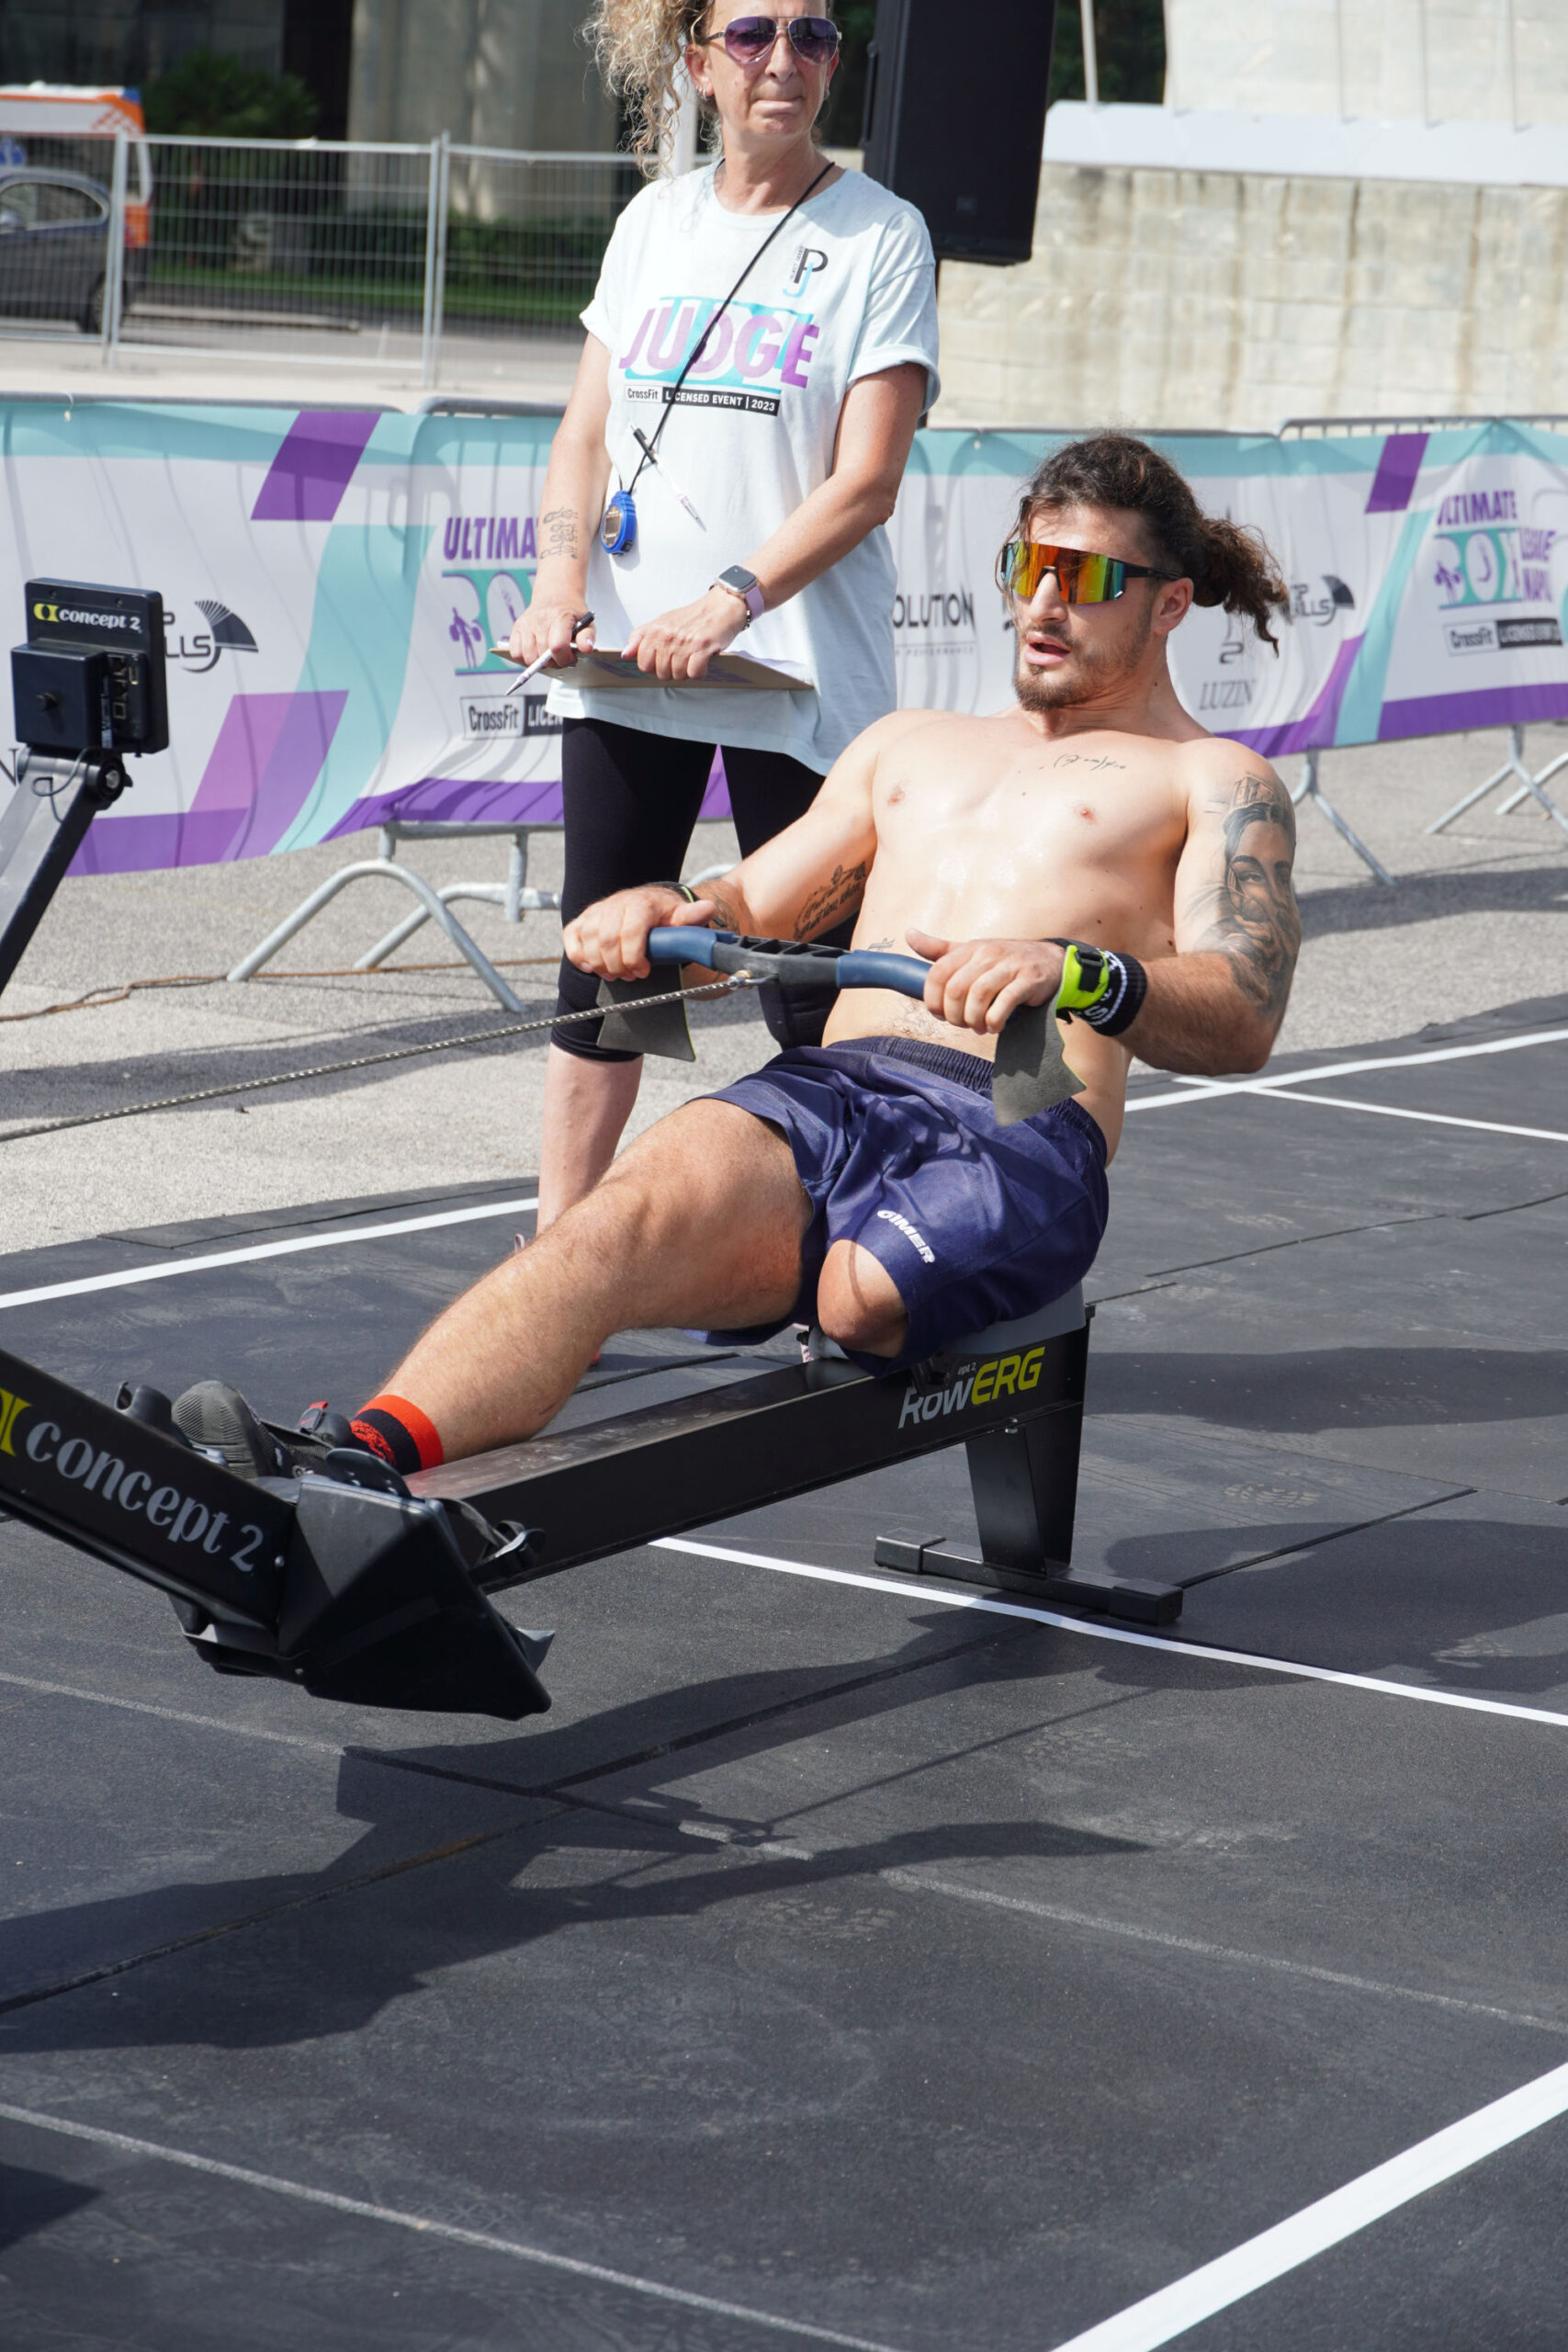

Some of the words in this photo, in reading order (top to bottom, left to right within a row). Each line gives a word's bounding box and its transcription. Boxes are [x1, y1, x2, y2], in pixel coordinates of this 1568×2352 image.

[618, 306, 820, 389] JUDGE
[627, 388, 659, 401] CrossFit
[665, 391, 710, 403] LCENSED
[712, 394, 742, 407] EVENT
[750, 399, 775, 413] 2023
[443, 516, 539, 560] ULTIMA
[59, 607, 127, 629] concept
[130, 616, 141, 631] 2
[892, 586, 976, 634] OLUTION
[468, 704, 519, 733] CrossFit
[26, 1419, 231, 1556] concept
[229, 1522, 265, 1574] 2
